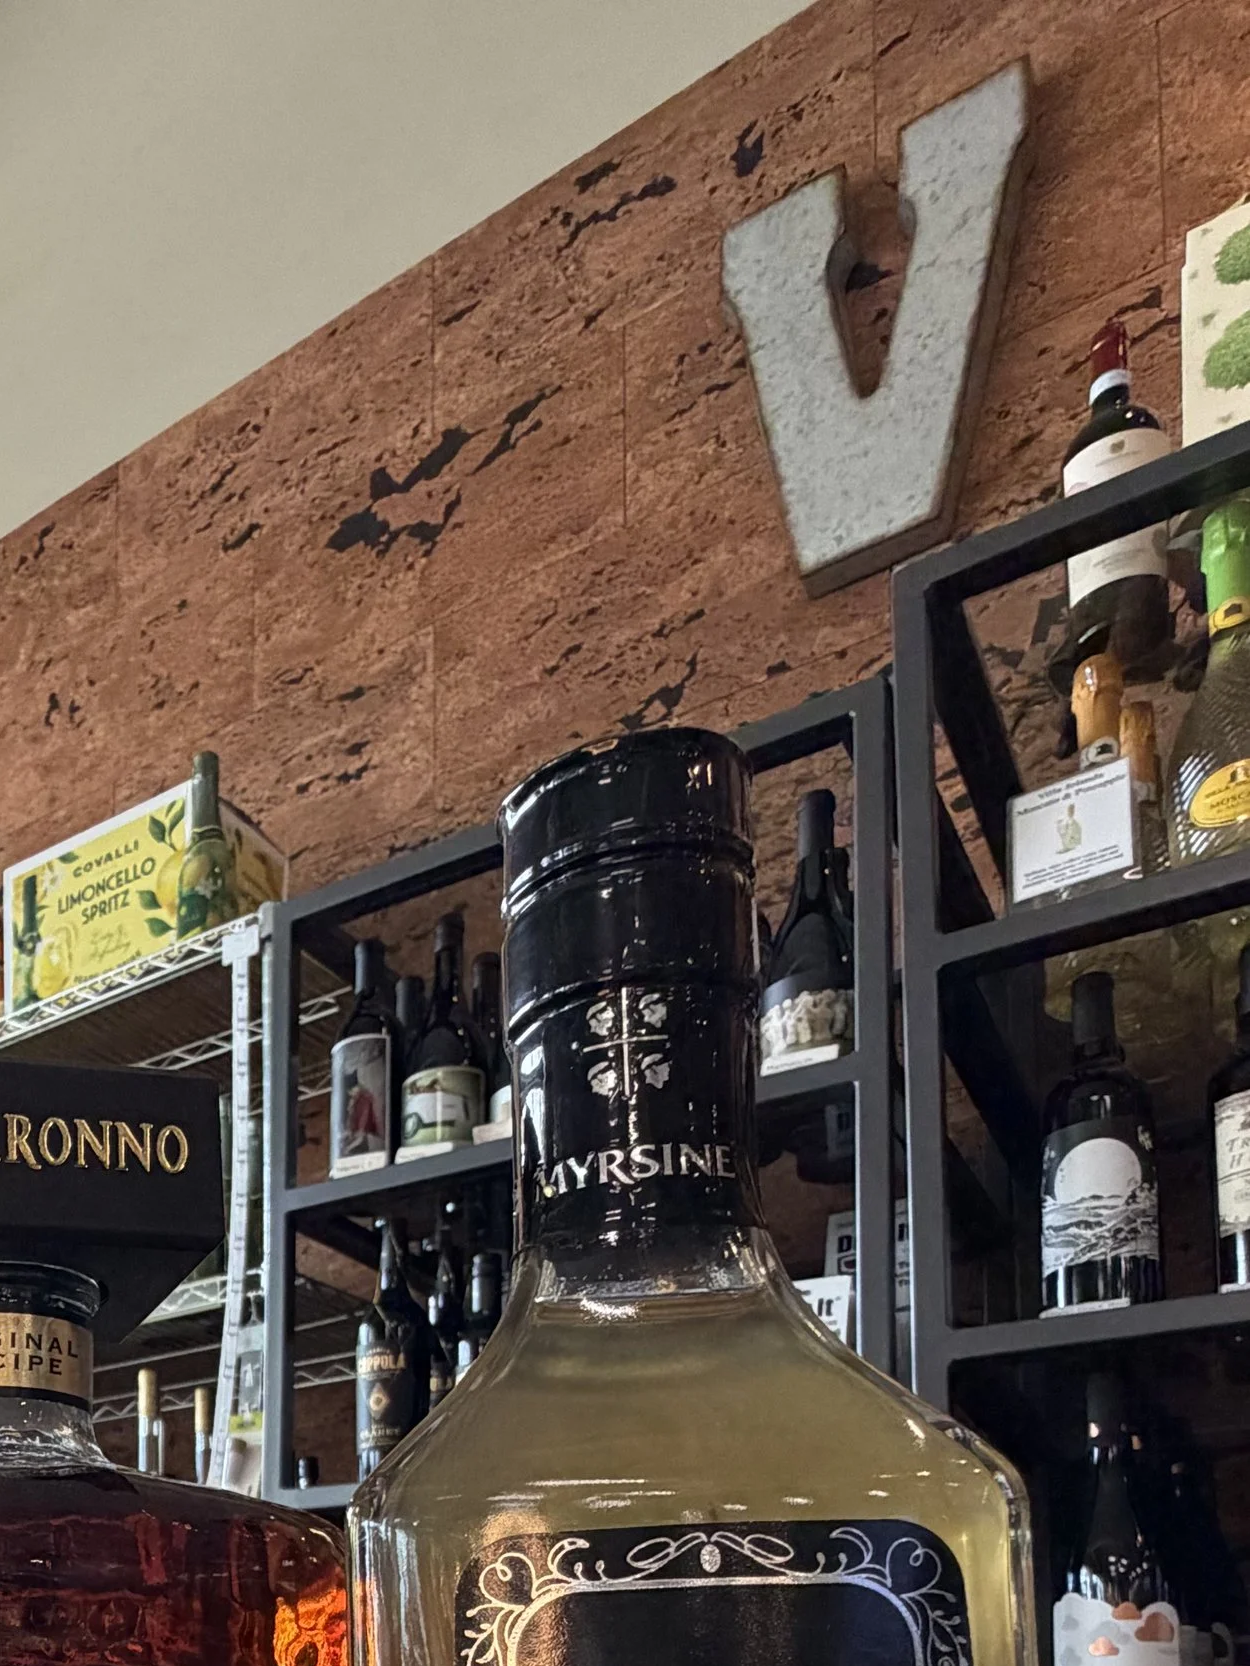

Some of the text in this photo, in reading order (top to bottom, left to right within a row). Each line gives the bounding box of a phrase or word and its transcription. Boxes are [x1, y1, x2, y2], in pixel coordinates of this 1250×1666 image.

[722, 55, 1035, 598] V
[57, 856, 156, 915] LIMONCELLO
[72, 840, 139, 878] COVALLI
[81, 887, 131, 925] SPRITZ
[534, 1143, 737, 1199] MYRSINE
